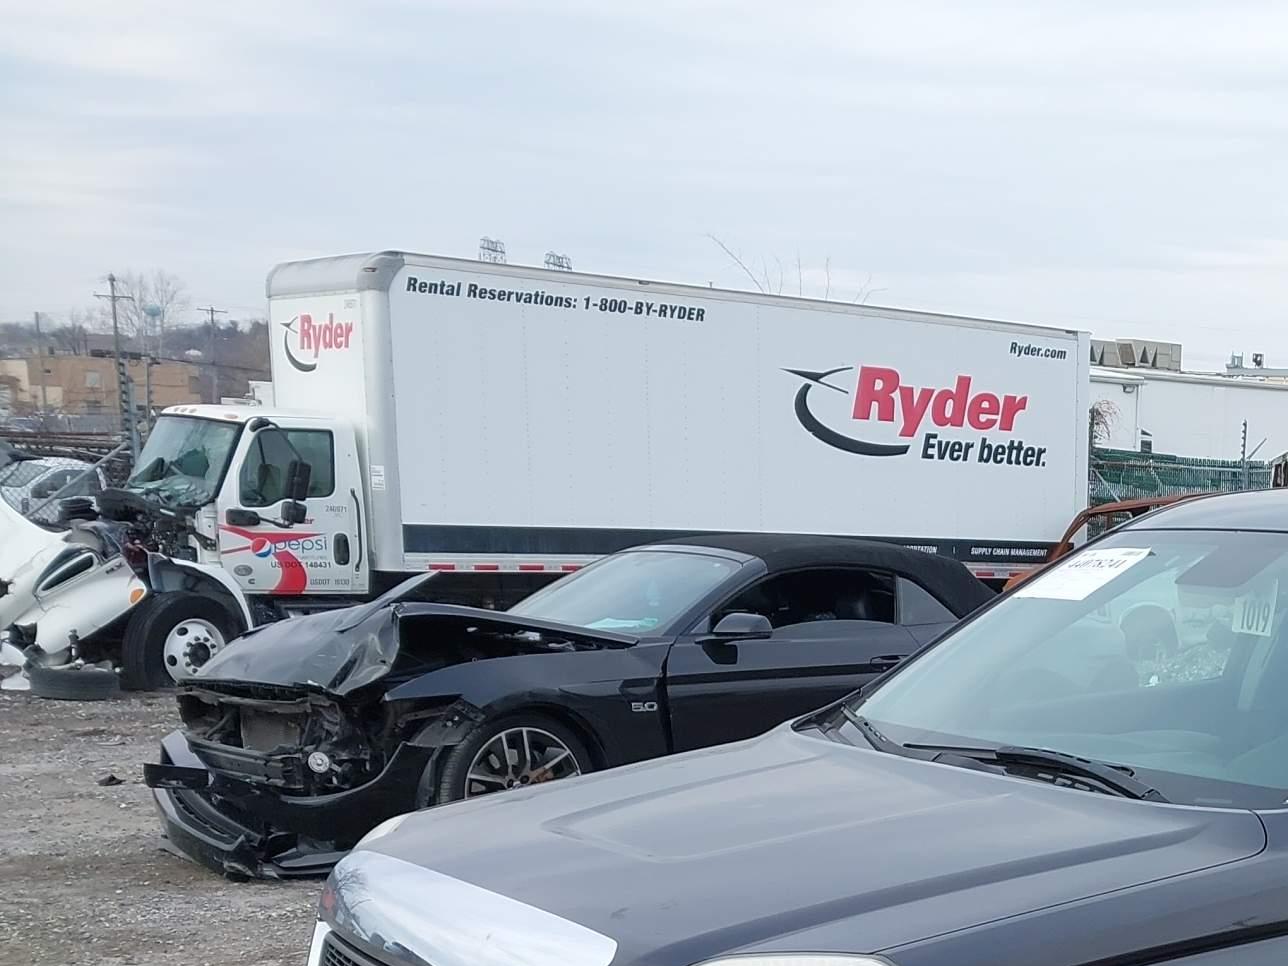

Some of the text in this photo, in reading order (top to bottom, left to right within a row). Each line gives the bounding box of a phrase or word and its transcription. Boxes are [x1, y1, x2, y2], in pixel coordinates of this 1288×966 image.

[406, 276, 706, 323] Rental Reservations: 1-800-BY-RYDER
[300, 312, 353, 359] Ryder
[1009, 341, 1067, 361] Ryder.com
[852, 366, 1028, 438] Ryder
[921, 433, 1047, 468] Ever better.
[273, 537, 328, 553] pepsi
[970, 547, 992, 556] SUPPLY
[993, 547, 1010, 556] CHAIN
[1010, 548, 1048, 557] MANAGEMENT
[631, 701, 659, 712] 5.0
